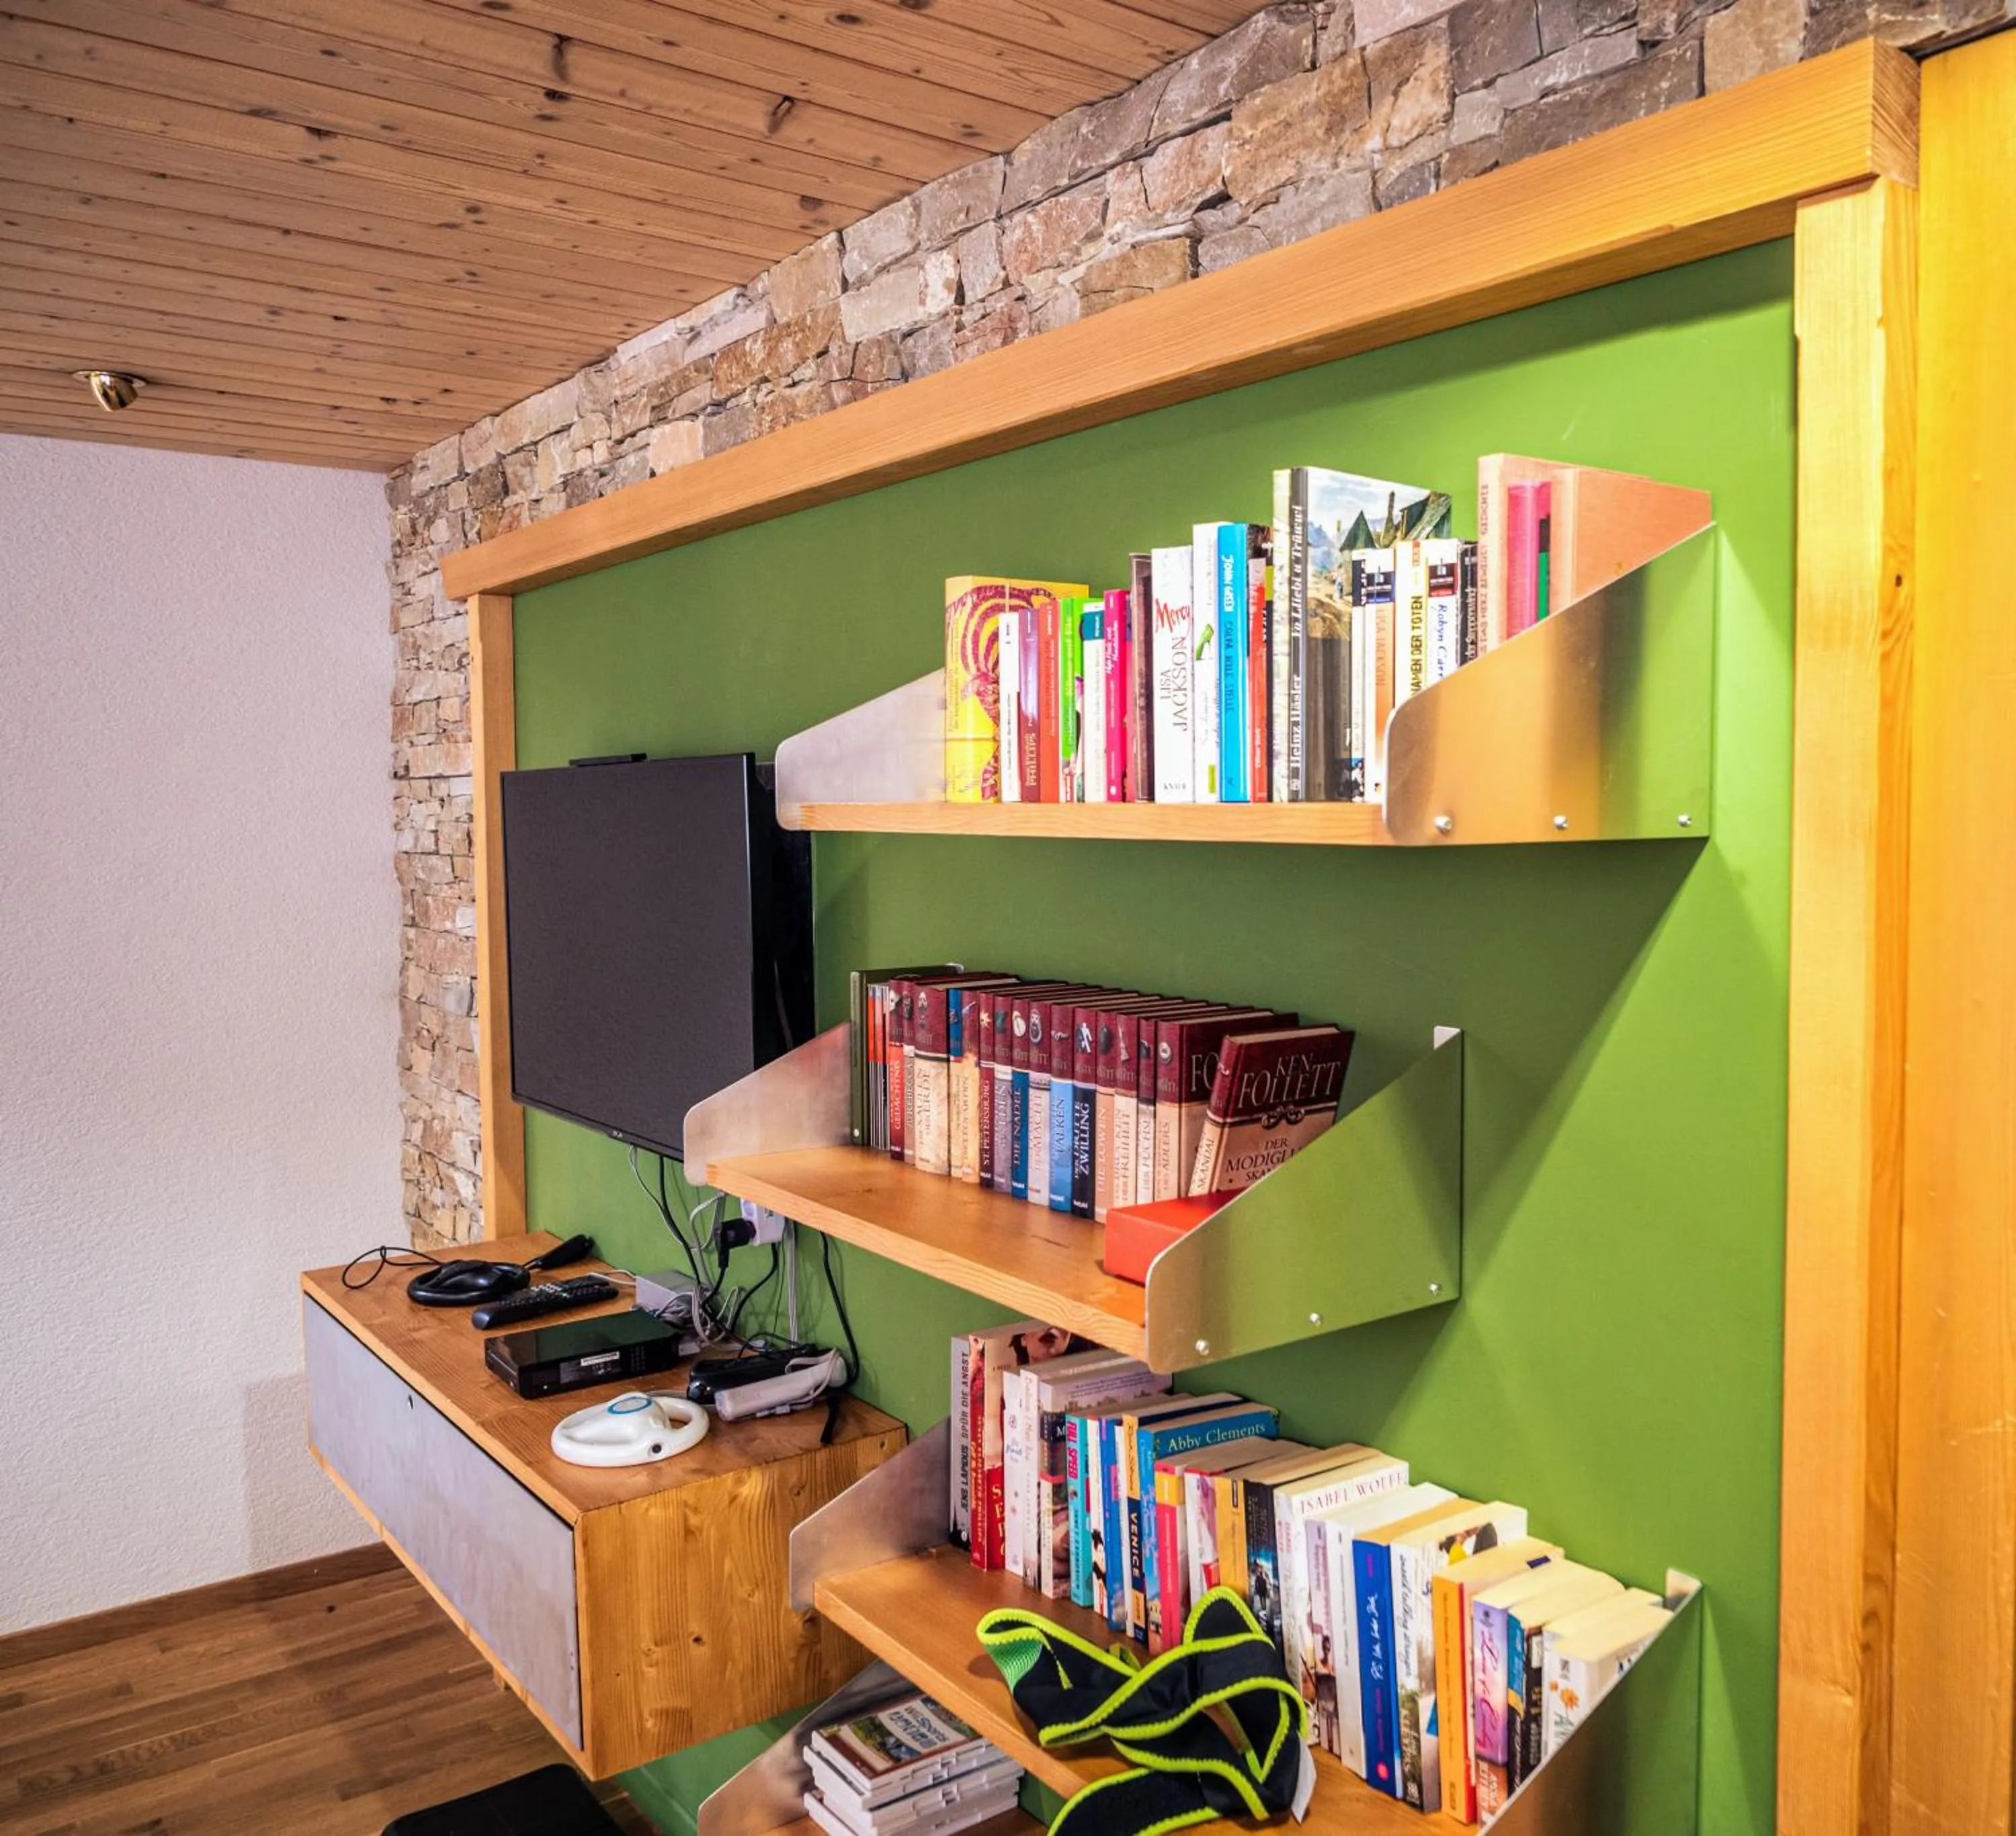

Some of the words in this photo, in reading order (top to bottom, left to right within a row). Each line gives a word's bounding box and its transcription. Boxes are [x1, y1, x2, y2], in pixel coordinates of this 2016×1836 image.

[1221, 554, 1234, 584] JOHN
[1155, 597, 1191, 636] Mercy
[1411, 595, 1423, 630] TOTEN
[1435, 603, 1448, 642] Robyn
[1411, 634, 1423, 656] DER
[1160, 669, 1171, 700] LISA
[1171, 636, 1188, 732] JACKSON
[1290, 675, 1301, 722] Häsler
[1290, 724, 1301, 767] Heinz
[1191, 1051, 1220, 1092] FO
[1275, 1052, 1314, 1078] KEN
[1238, 1061, 1341, 1109] FOLLETT
[982, 1079, 991, 1149] PETERSBURG
[1013, 1087, 1021, 1138] NADEL
[1080, 1102, 1090, 1175] ZWILLING
[1263, 1137, 1288, 1151] DER
[1197, 1138, 1214, 1190] SKANDAL
[1226, 1146, 1302, 1173] MODIGLI
[1246, 1167, 1271, 1181] SKA
[961, 1351, 969, 1387] ANGST
[961, 1390, 969, 1408] DIE
[959, 1411, 969, 1439] SPÜR
[1066, 1420, 1079, 1444] FULL
[1168, 1435, 1201, 1453] Abby
[1206, 1422, 1267, 1444] Clements
[960, 1444, 968, 1481] LAPIDUS
[1067, 1447, 1079, 1480] SPEED
[960, 1483, 968, 1512] JENS
[1300, 1487, 1348, 1515] ISABEL
[1130, 1512, 1140, 1578] VENICE
[917, 1716, 950, 1743] Sports
